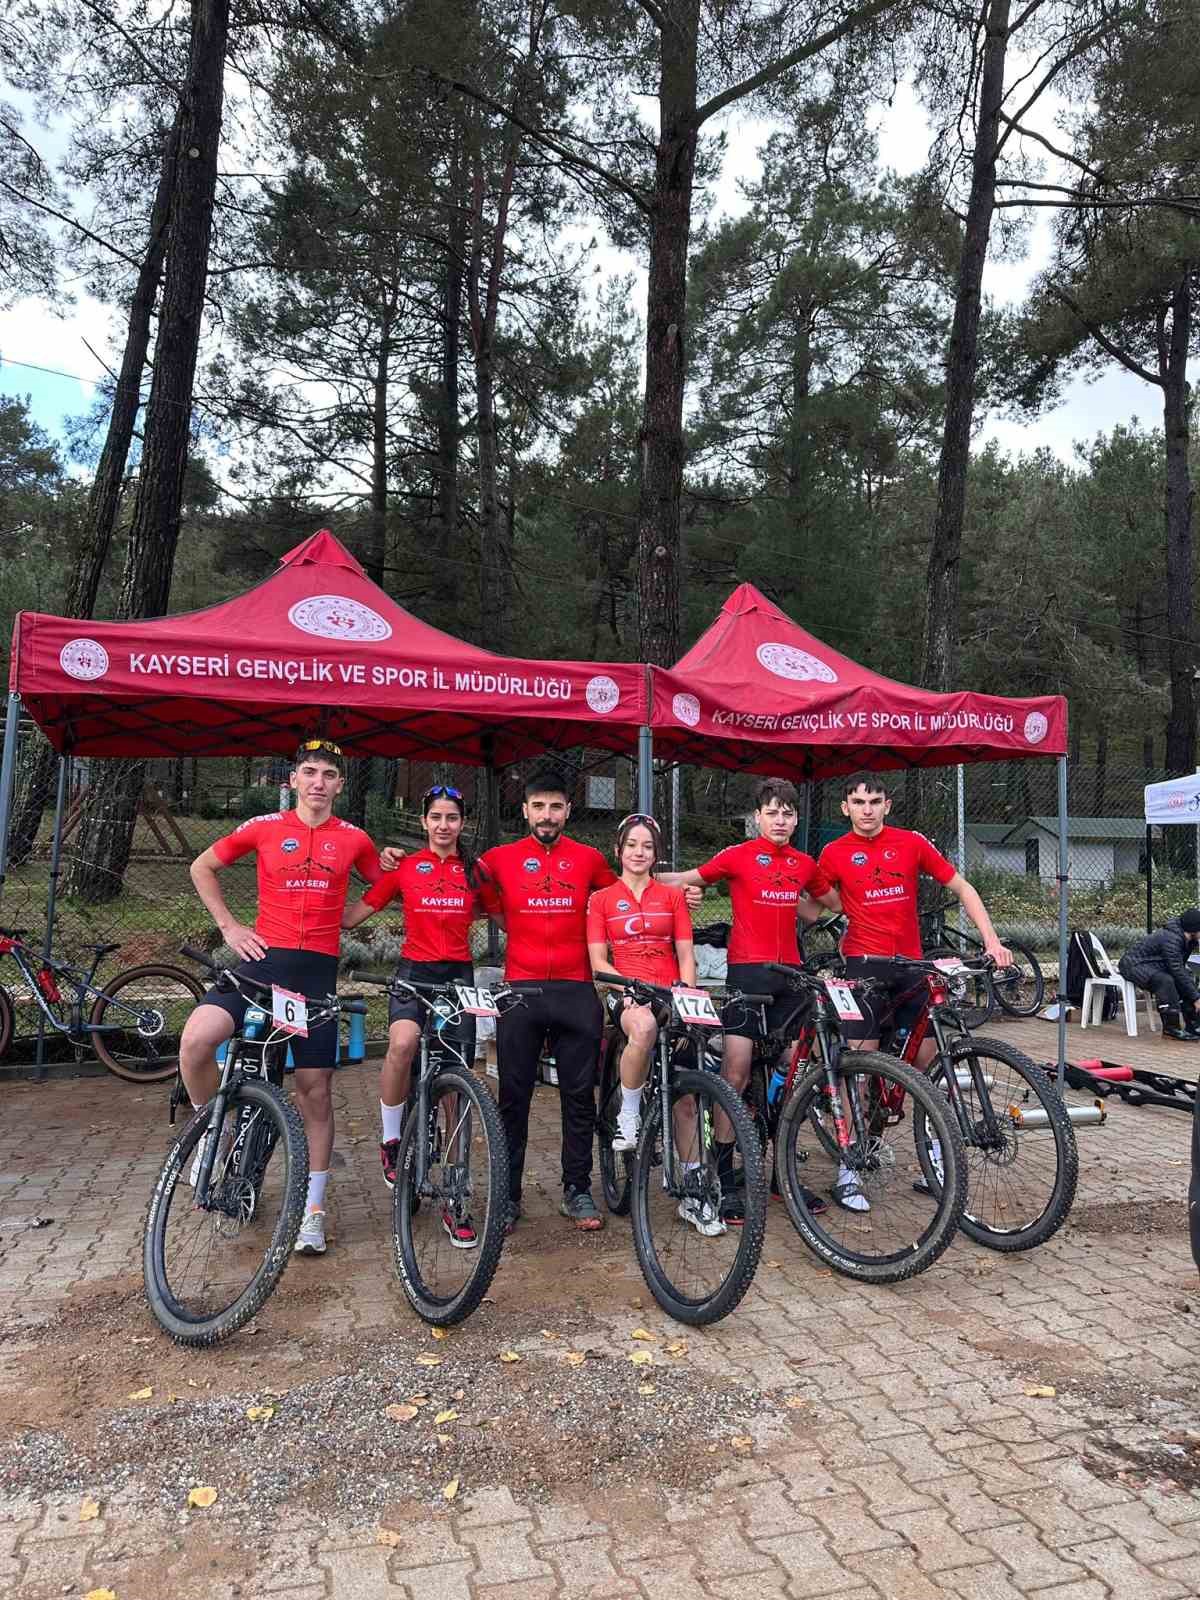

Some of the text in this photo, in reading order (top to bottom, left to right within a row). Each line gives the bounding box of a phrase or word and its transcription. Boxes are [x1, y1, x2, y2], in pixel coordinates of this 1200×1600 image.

[129, 653, 572, 699] KAYSERİ GENÇLİK VE SPOR İL MÜDÜRLÜĞÜ
[711, 709, 1014, 733] KAYSERİ GENÇLİK VE SPOR İL MÜDÜRLÜĞÜ
[528, 895, 573, 907] KAYSERİ
[865, 884, 904, 899] KAYSERİ
[460, 987, 495, 1010] 175
[676, 997, 716, 1019] 174
[838, 989, 851, 1011] 5
[285, 1000, 295, 1022] 6
[243, 1058, 259, 1073] 01
